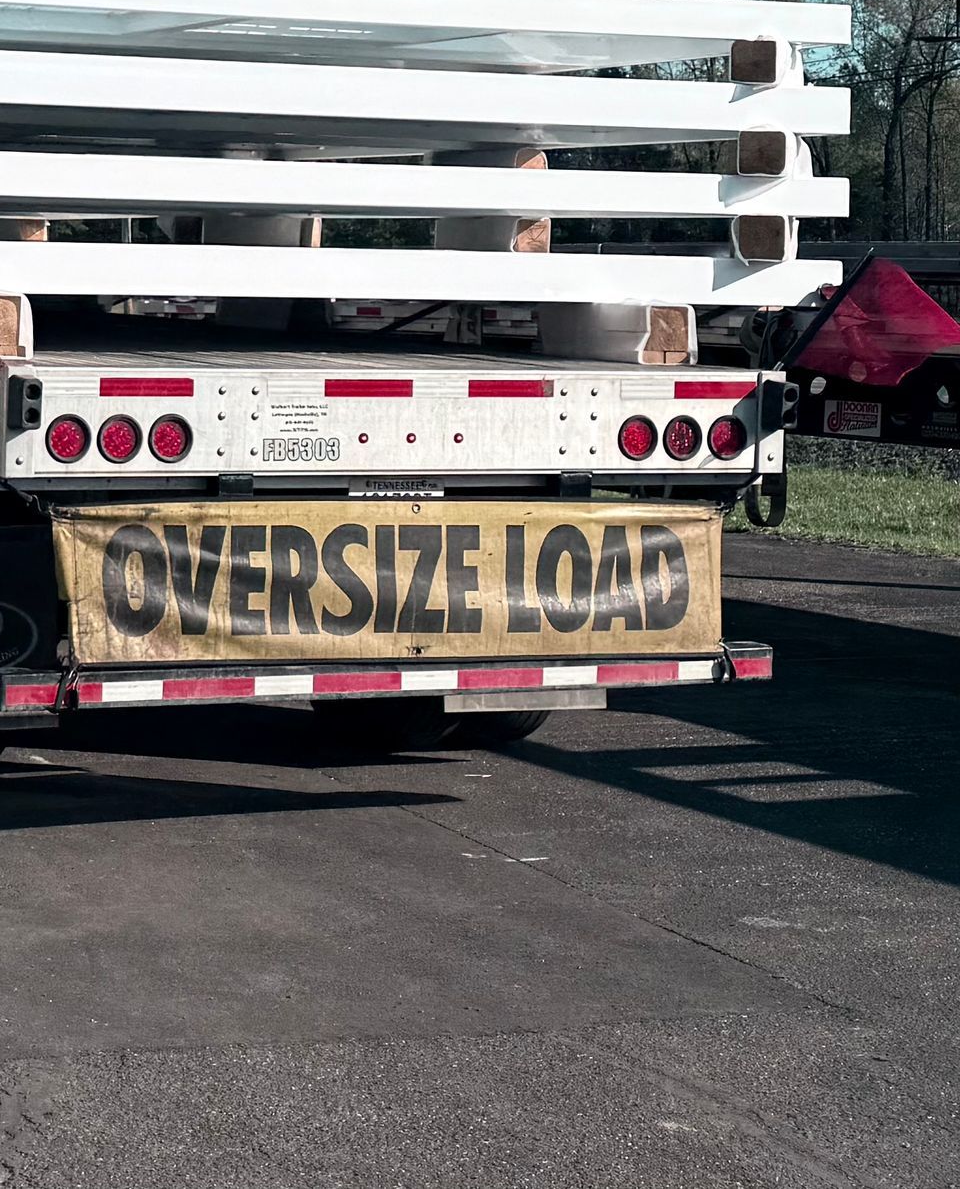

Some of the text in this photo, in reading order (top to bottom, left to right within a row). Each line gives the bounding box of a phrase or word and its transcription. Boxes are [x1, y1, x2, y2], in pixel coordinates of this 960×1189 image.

[263, 438, 340, 461] FB5303
[373, 481, 425, 490] TENNESSEE
[102, 523, 689, 637] OVERSIZE LOAD
